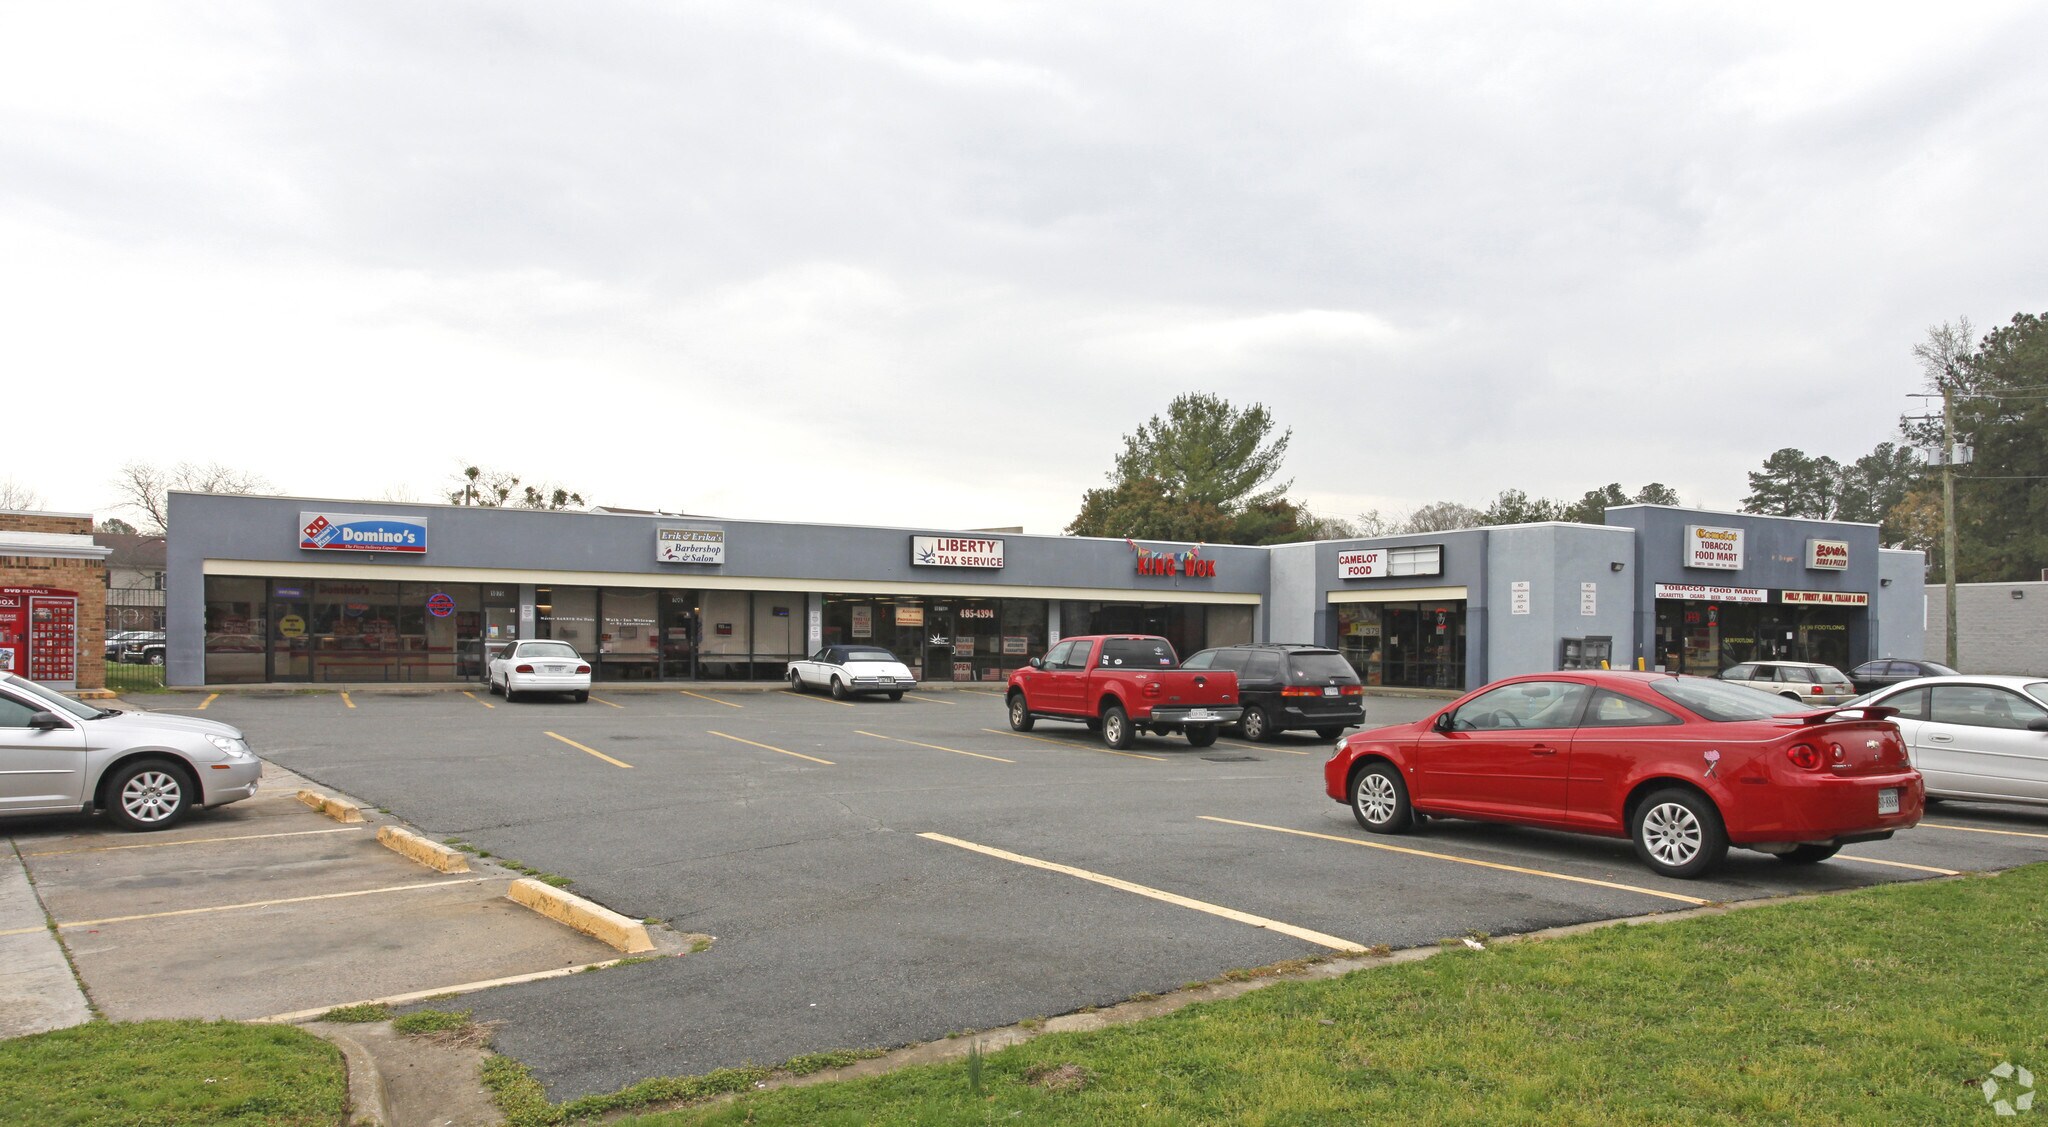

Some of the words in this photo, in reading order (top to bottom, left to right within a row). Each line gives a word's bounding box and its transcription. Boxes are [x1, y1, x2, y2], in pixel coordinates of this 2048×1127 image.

[343, 527, 416, 544] Domino's
[662, 532, 681, 540] Erik
[682, 532, 691, 540] &
[692, 532, 722, 542] Erika's
[675, 544, 721, 556] Barbershop
[938, 539, 995, 553] LIBERTY
[1701, 541, 1732, 551] TOBACCO
[682, 553, 690, 562] &
[691, 554, 714, 562] Salon
[938, 556, 958, 564] TAX
[961, 556, 1002, 566] SERVICE
[1339, 554, 1378, 564] CAMELOT
[1696, 551, 1714, 560] FOOD
[1717, 552, 1738, 562] MART
[1138, 556, 1176, 576] KING
[1184, 560, 1216, 578] WOK
[1348, 566, 1372, 576] FOOD
[960, 609, 994, 618] 485-4394
